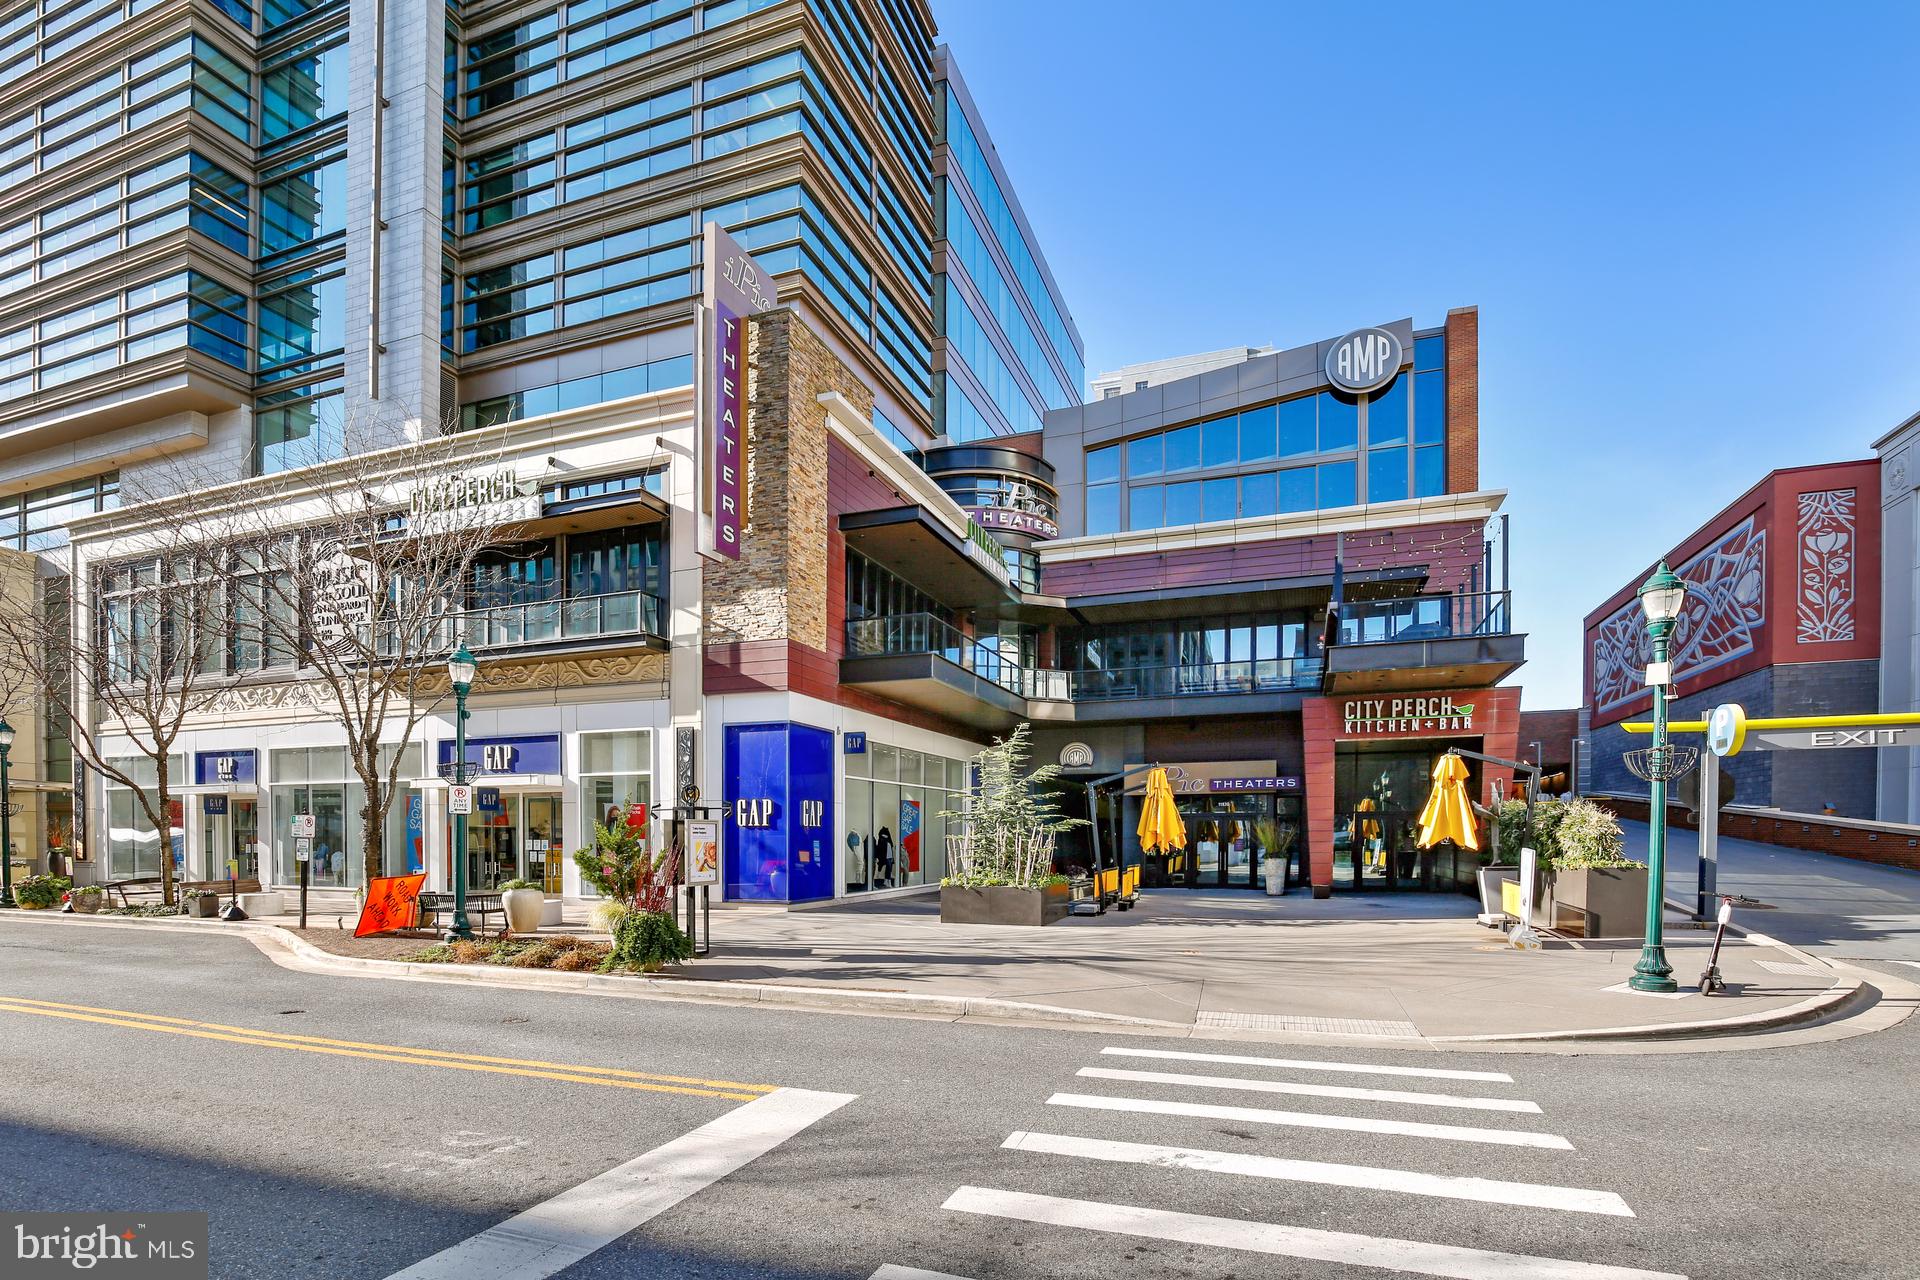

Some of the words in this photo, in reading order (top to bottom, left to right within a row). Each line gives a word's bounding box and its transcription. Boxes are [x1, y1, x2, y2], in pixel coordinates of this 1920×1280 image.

[1338, 335, 1391, 381] AMP
[723, 317, 736, 543] THEATERS
[454, 469, 516, 509] PERCH
[966, 511, 1058, 537] THEATERS
[1345, 701, 1384, 719] CITY
[1392, 697, 1452, 717] PERCH
[1345, 719, 1420, 733] KITCHEN
[1440, 717, 1472, 730] BAR
[847, 737, 862, 748] GAP
[1811, 728, 1904, 746] EXIT
[217, 758, 233, 773] GAP
[484, 745, 512, 770] GAP
[1069, 751, 1084, 764] AMP
[1213, 778, 1296, 789] THEATERS
[209, 799, 223, 807] GAP
[482, 793, 496, 806] GAP
[737, 799, 772, 827] GAP
[803, 800, 823, 827] GAP
[396, 880, 412, 903] ROAD
[383, 891, 402, 917] WORK
[367, 903, 390, 929] AHEAD
